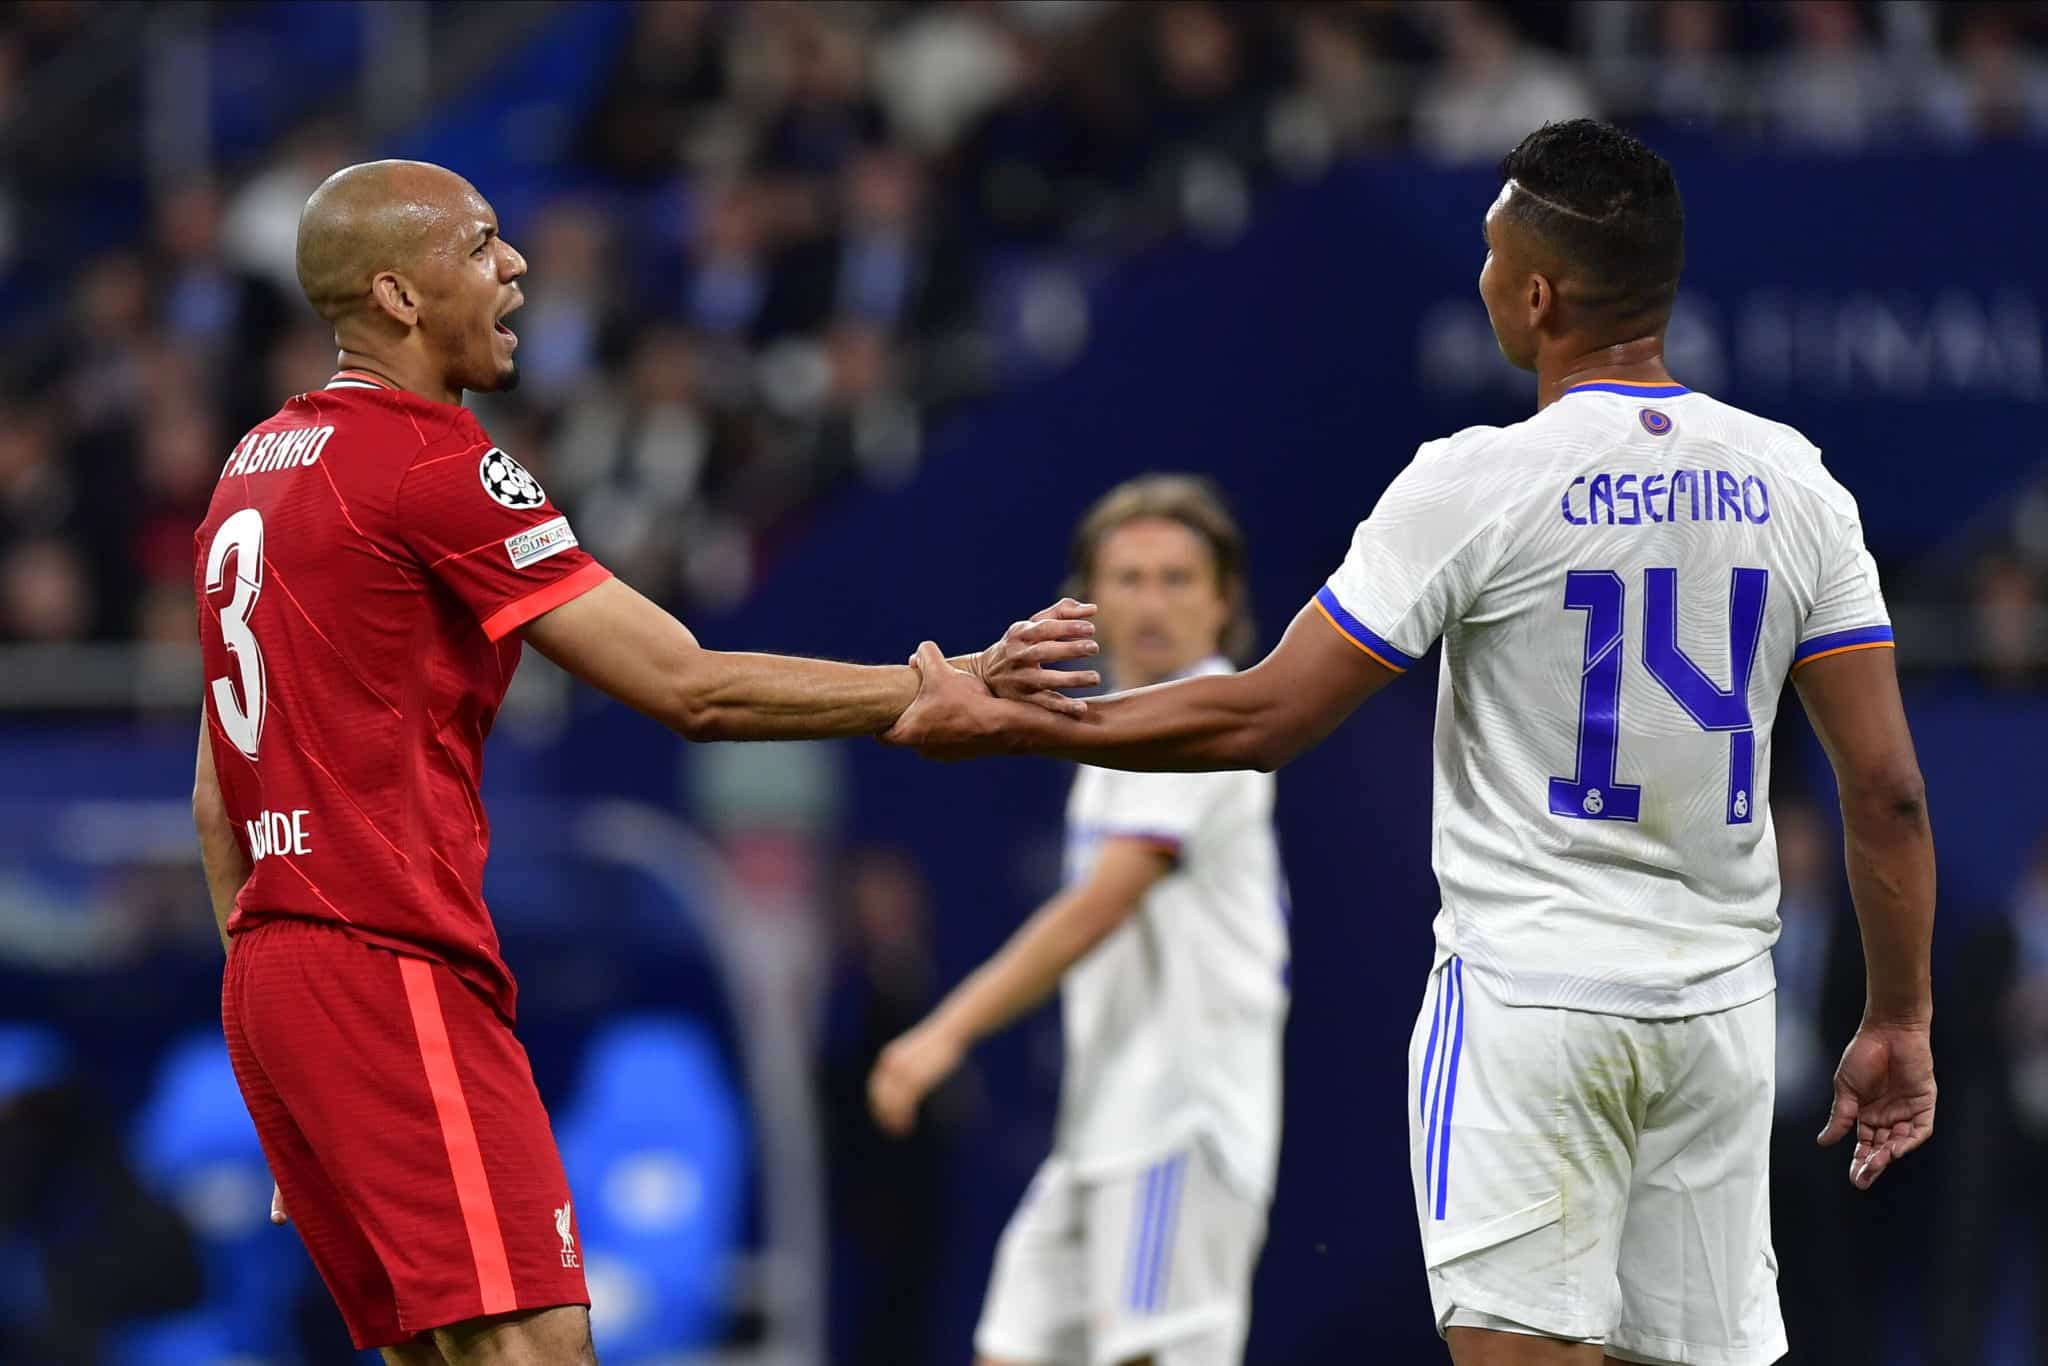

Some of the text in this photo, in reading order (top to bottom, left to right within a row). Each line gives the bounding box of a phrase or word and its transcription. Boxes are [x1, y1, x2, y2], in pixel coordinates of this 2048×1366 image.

[1561, 470, 1770, 525] CASEMIRO
[205, 508, 267, 761] 3
[1549, 567, 1769, 825] 14
